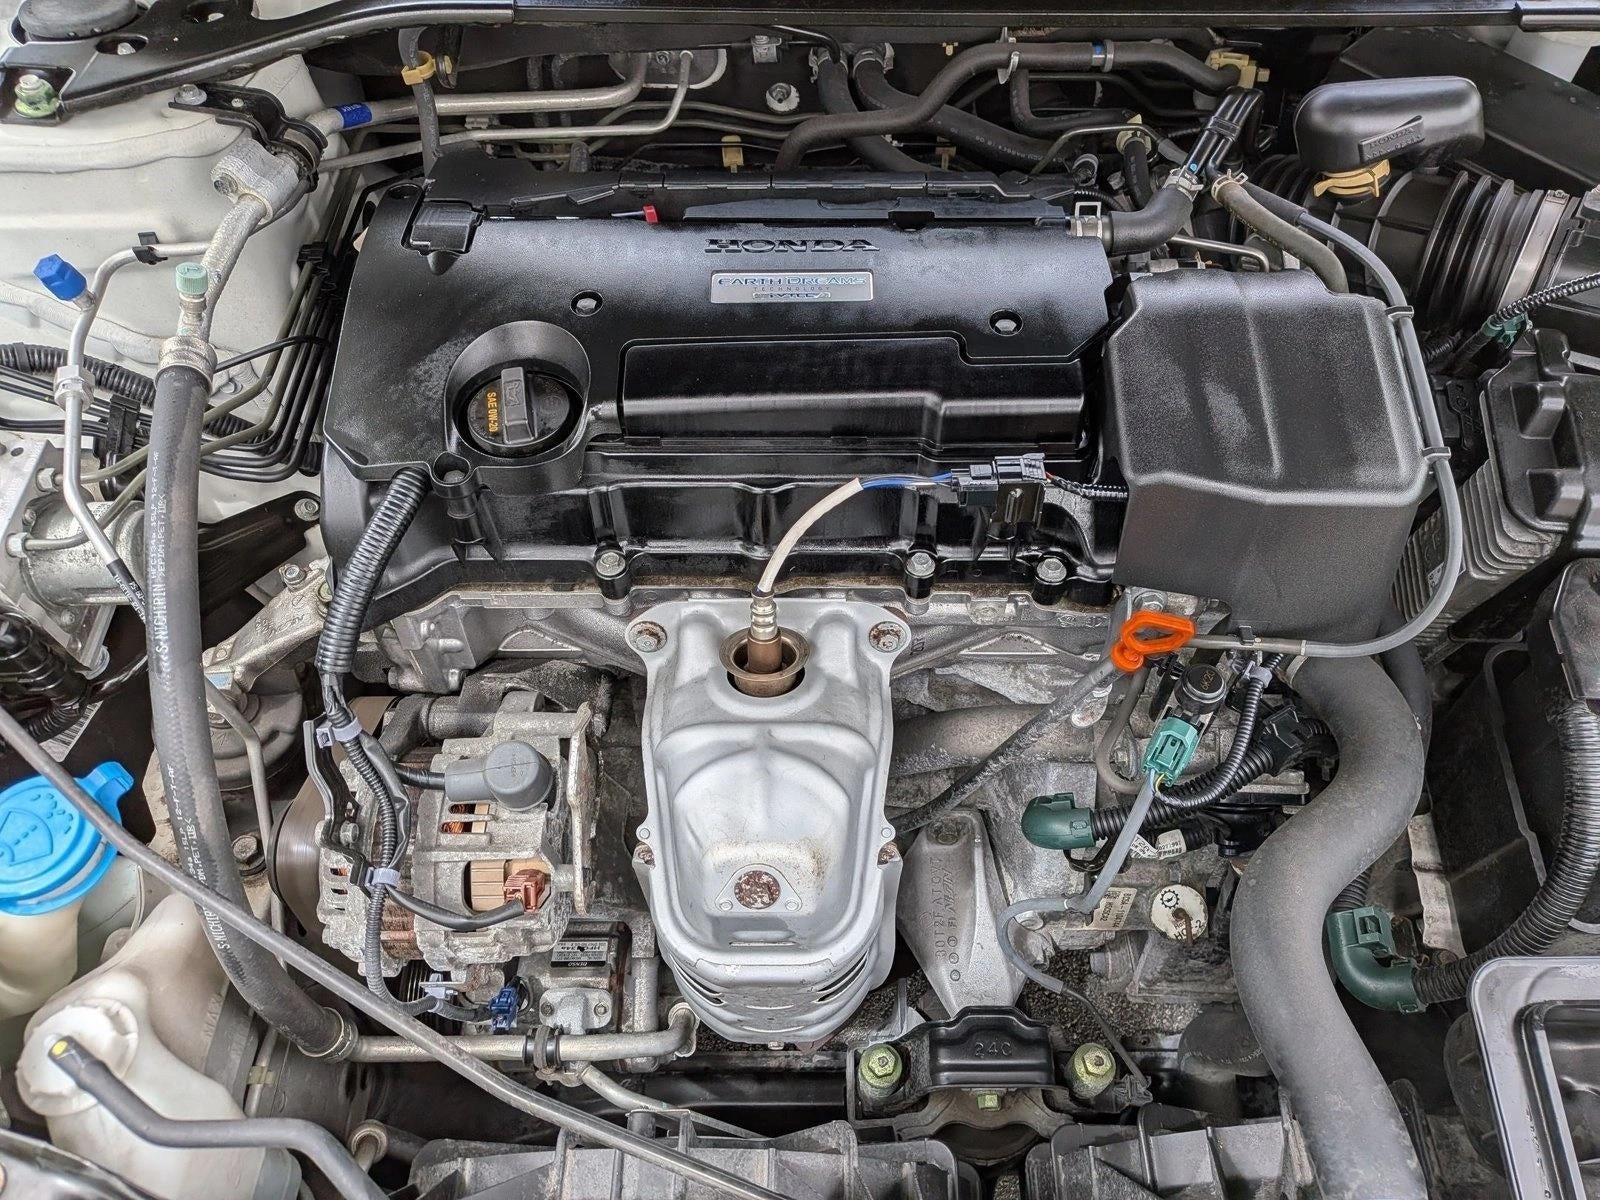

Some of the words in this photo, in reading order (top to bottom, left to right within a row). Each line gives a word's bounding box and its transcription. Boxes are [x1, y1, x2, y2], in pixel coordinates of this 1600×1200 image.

[705, 239, 880, 253] HONDA
[718, 277, 782, 285] EARTH
[787, 276, 867, 285] DREAMS
[487, 392, 497, 408] SAE
[488, 409, 499, 432] 0W-20
